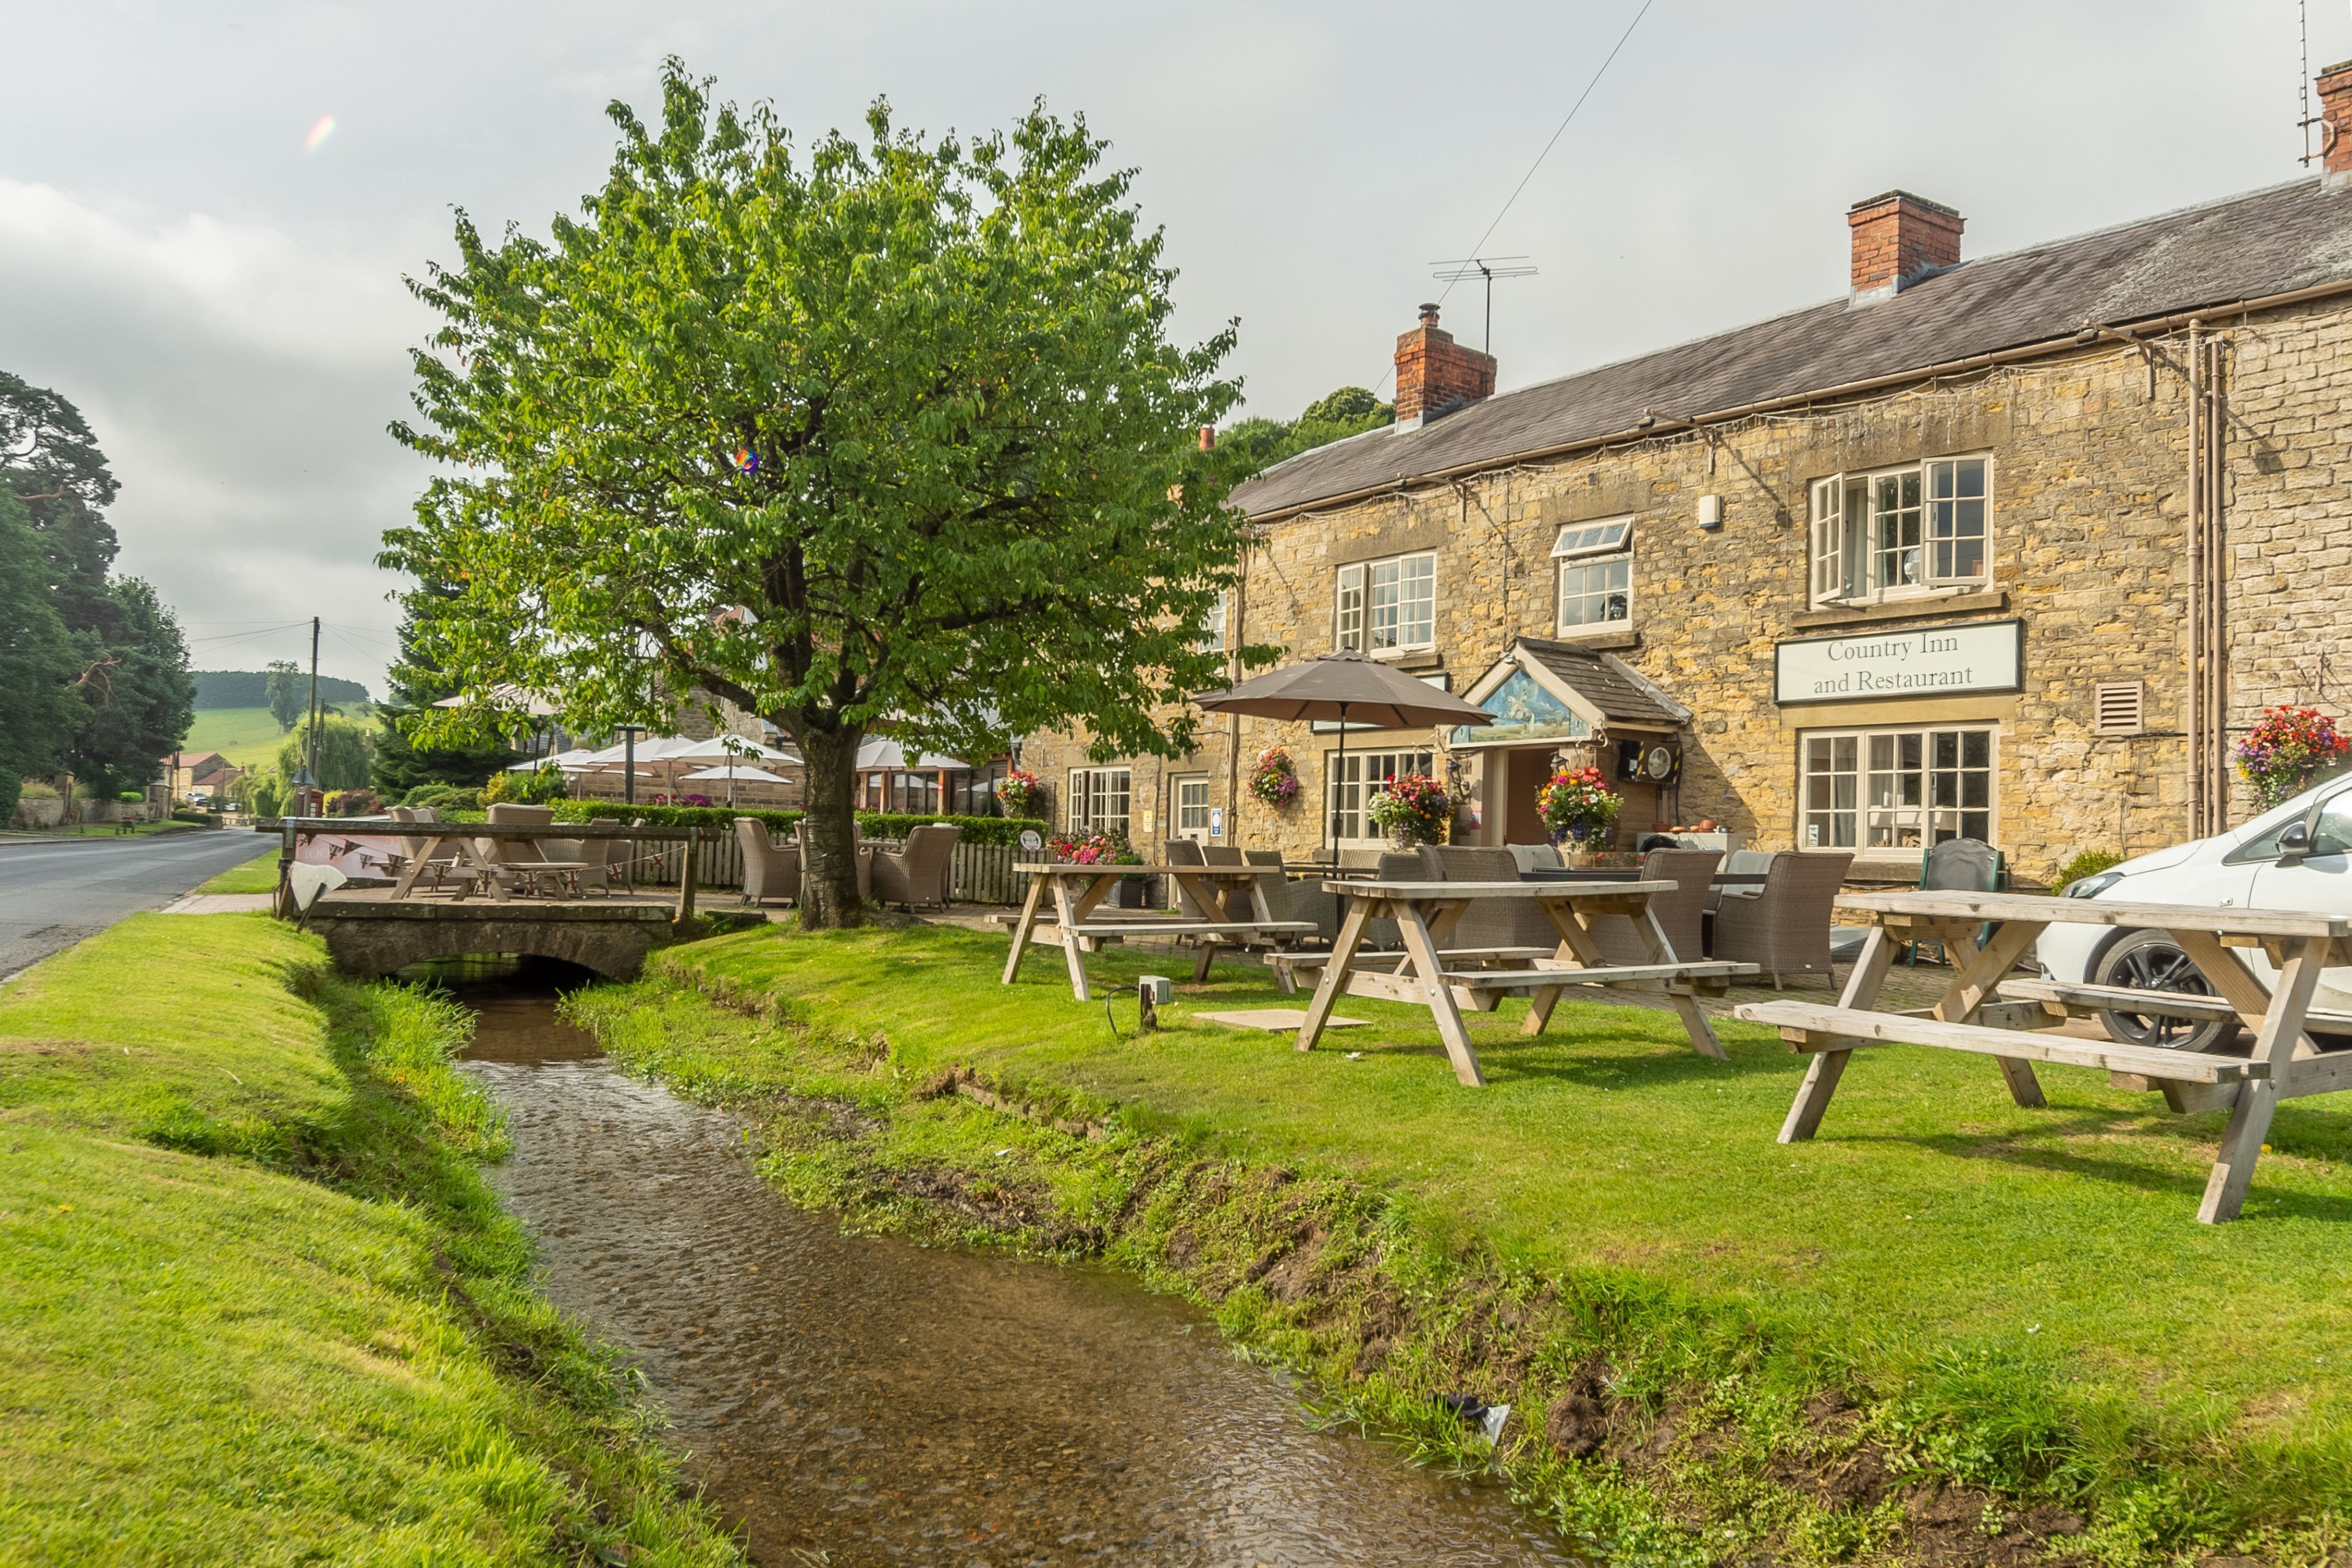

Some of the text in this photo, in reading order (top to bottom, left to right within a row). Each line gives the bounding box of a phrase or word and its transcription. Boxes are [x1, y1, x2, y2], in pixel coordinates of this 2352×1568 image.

[1828, 633, 1959, 661] Country Inn
[1814, 667, 1973, 694] and Restaurant
